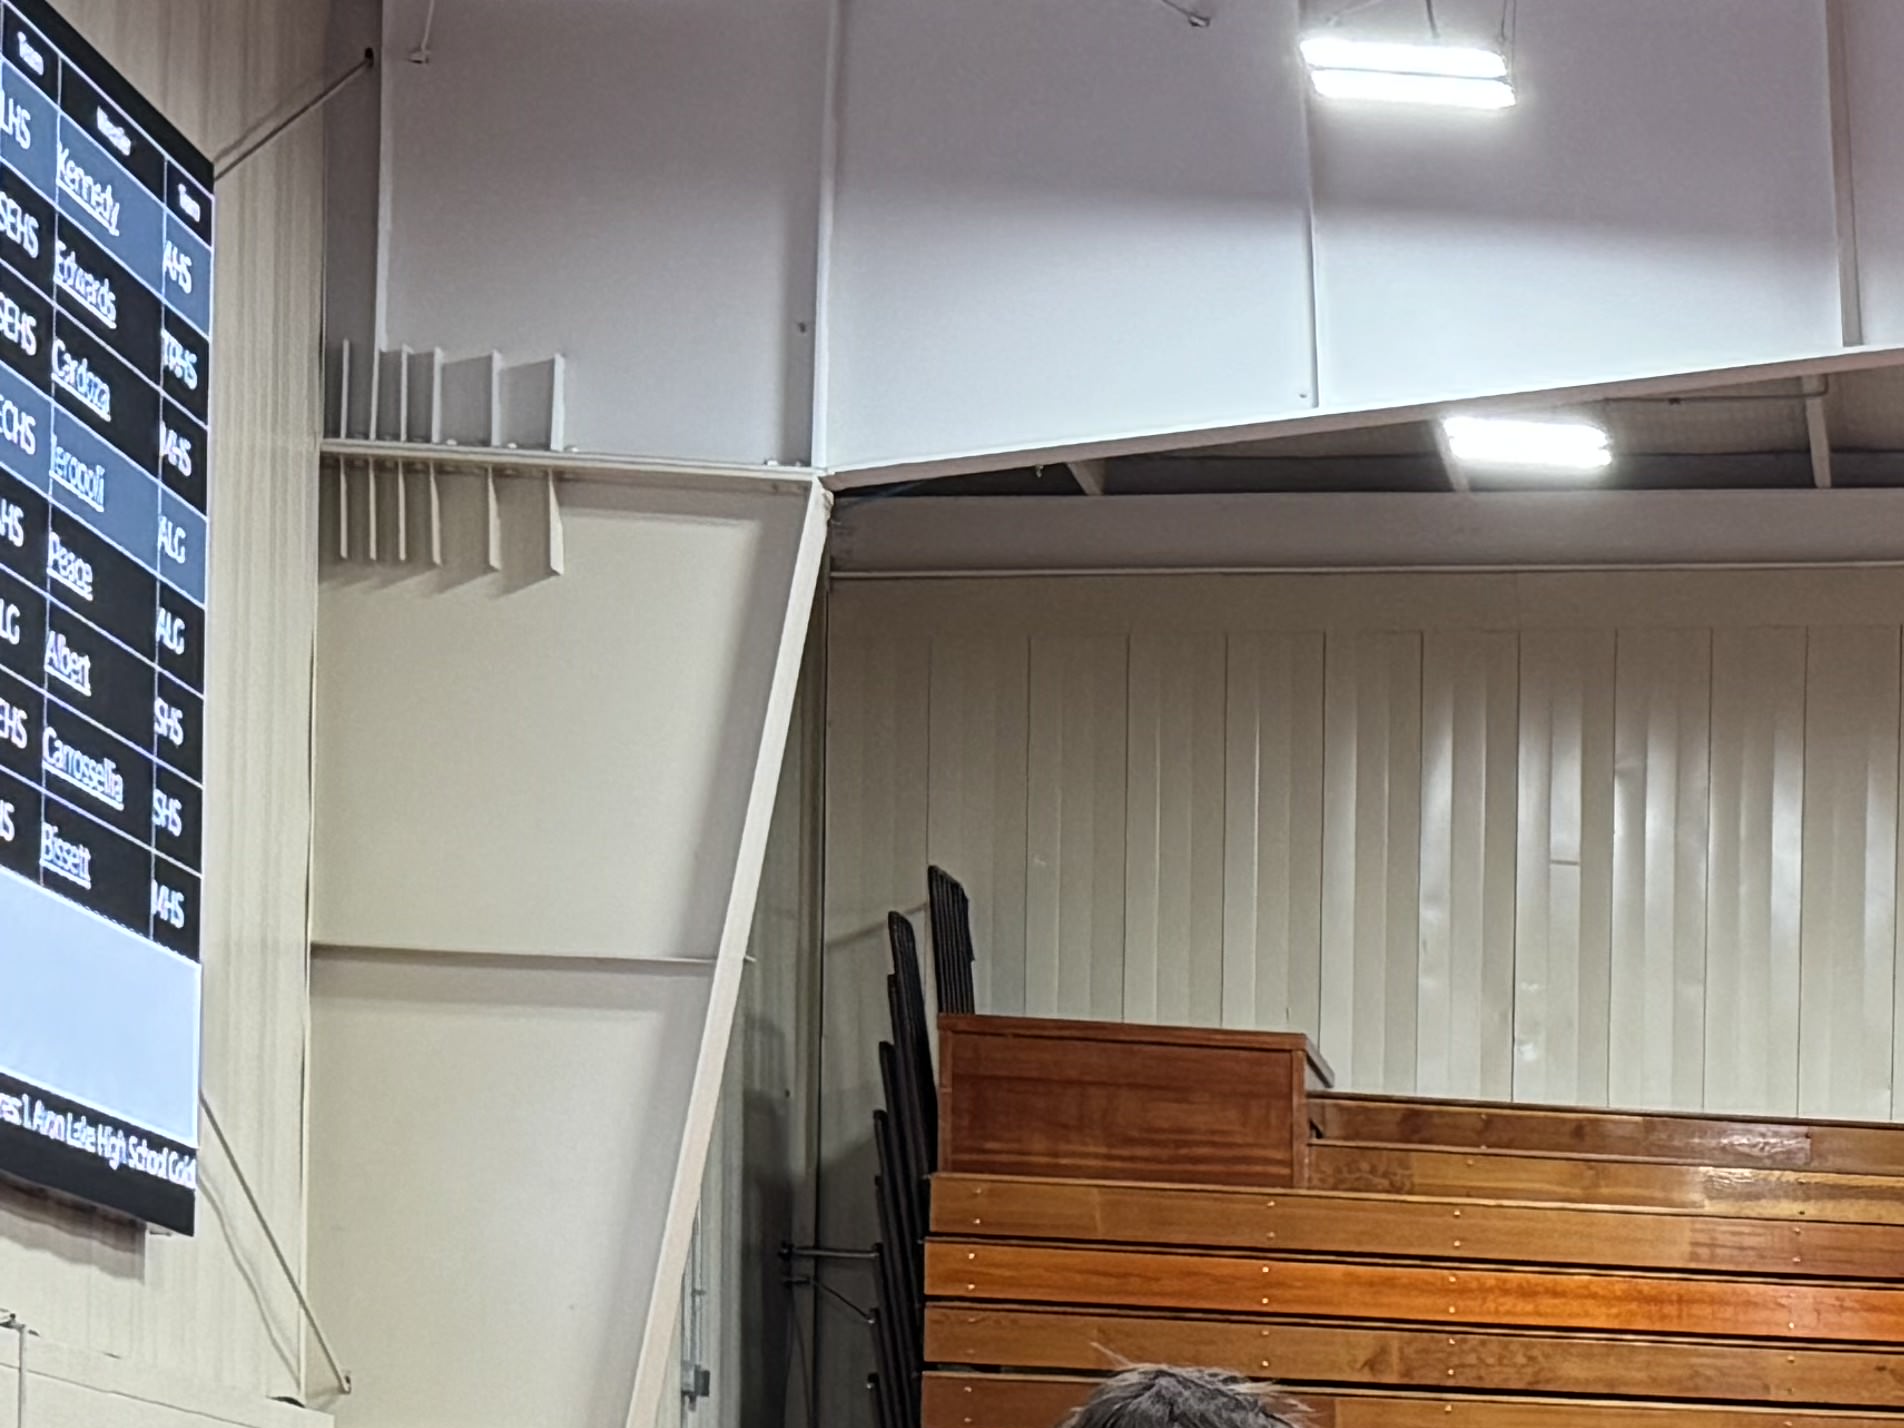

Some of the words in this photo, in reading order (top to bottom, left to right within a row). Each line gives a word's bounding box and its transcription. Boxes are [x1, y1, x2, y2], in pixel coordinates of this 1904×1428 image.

[57, 141, 119, 236] Kennedy
[55, 239, 117, 322] Edwards
[49, 532, 93, 597] Peace
[46, 630, 91, 694] Albert
[97, 1124, 127, 1171] High
